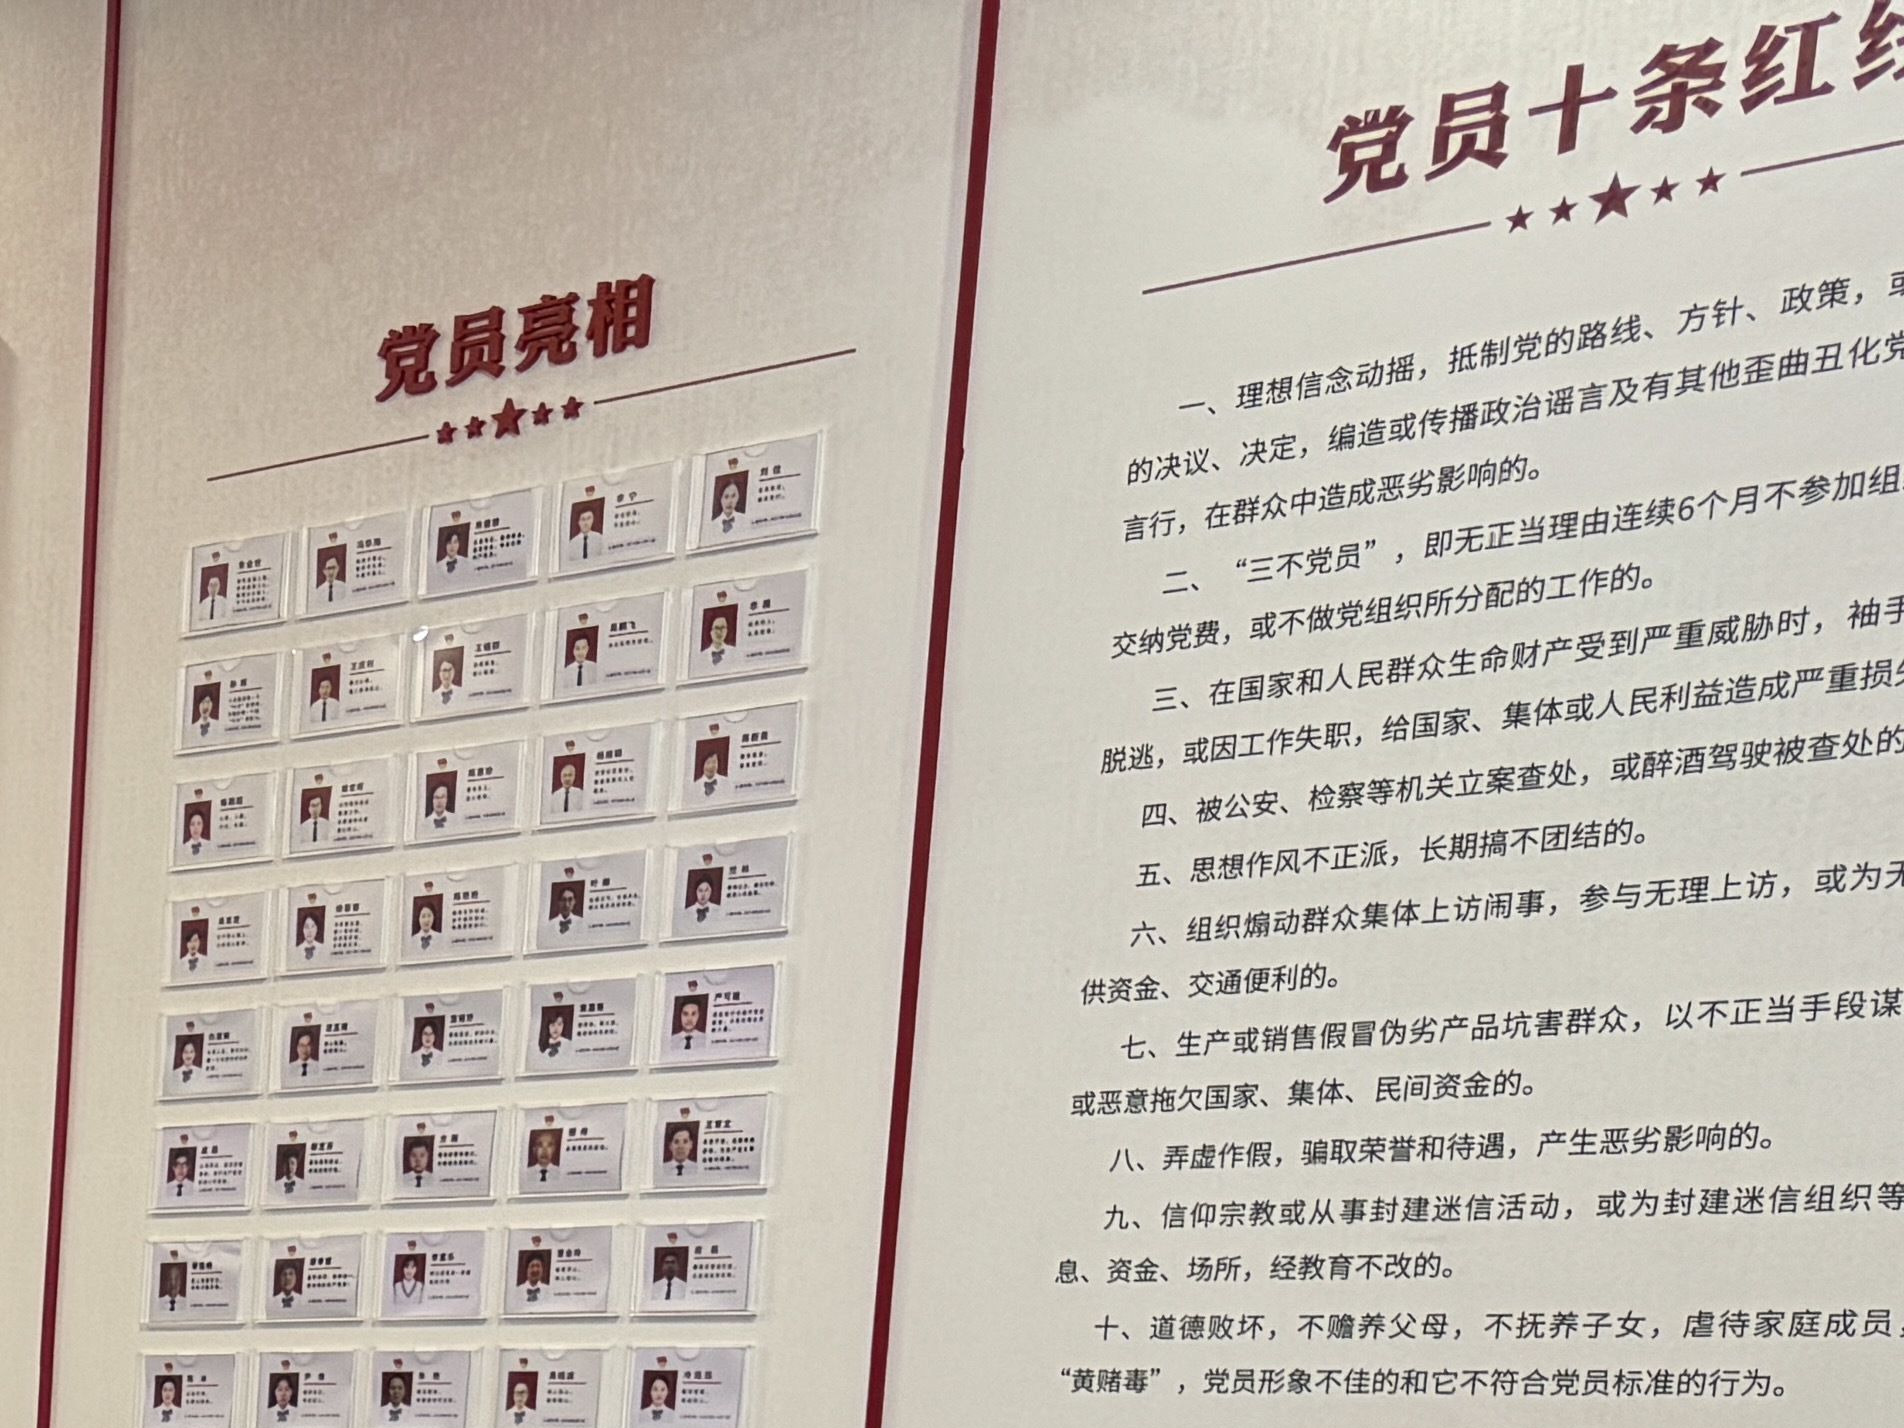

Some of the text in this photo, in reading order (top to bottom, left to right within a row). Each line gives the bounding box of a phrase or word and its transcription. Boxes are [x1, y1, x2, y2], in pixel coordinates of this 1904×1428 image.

[375, 273, 656, 402] 党员亮相
[1123, 455, 1543, 544] 言行，在群众中造成恶劣影响的。
[1161, 463, 1904, 595] 二、“三不党员”，即无正当理由连续6个月不参加组
[1110, 561, 1658, 660] 交纳党费，或不做党组织所分配的工作的。
[1135, 817, 1649, 888] 五、思想作风不正派，长期搞不团结的。
[1081, 963, 1343, 1006] 供资金、交通便利的。
[1071, 1069, 1537, 1119] 或恶意拖欠国家、集体、民间资金的。
[1109, 1123, 1775, 1173] 八、弄虚作假，骗取荣誉和待遇，产生恶劣影响的。
[1054, 1252, 1456, 1286] 息、资金、场所，经教育不改的。
